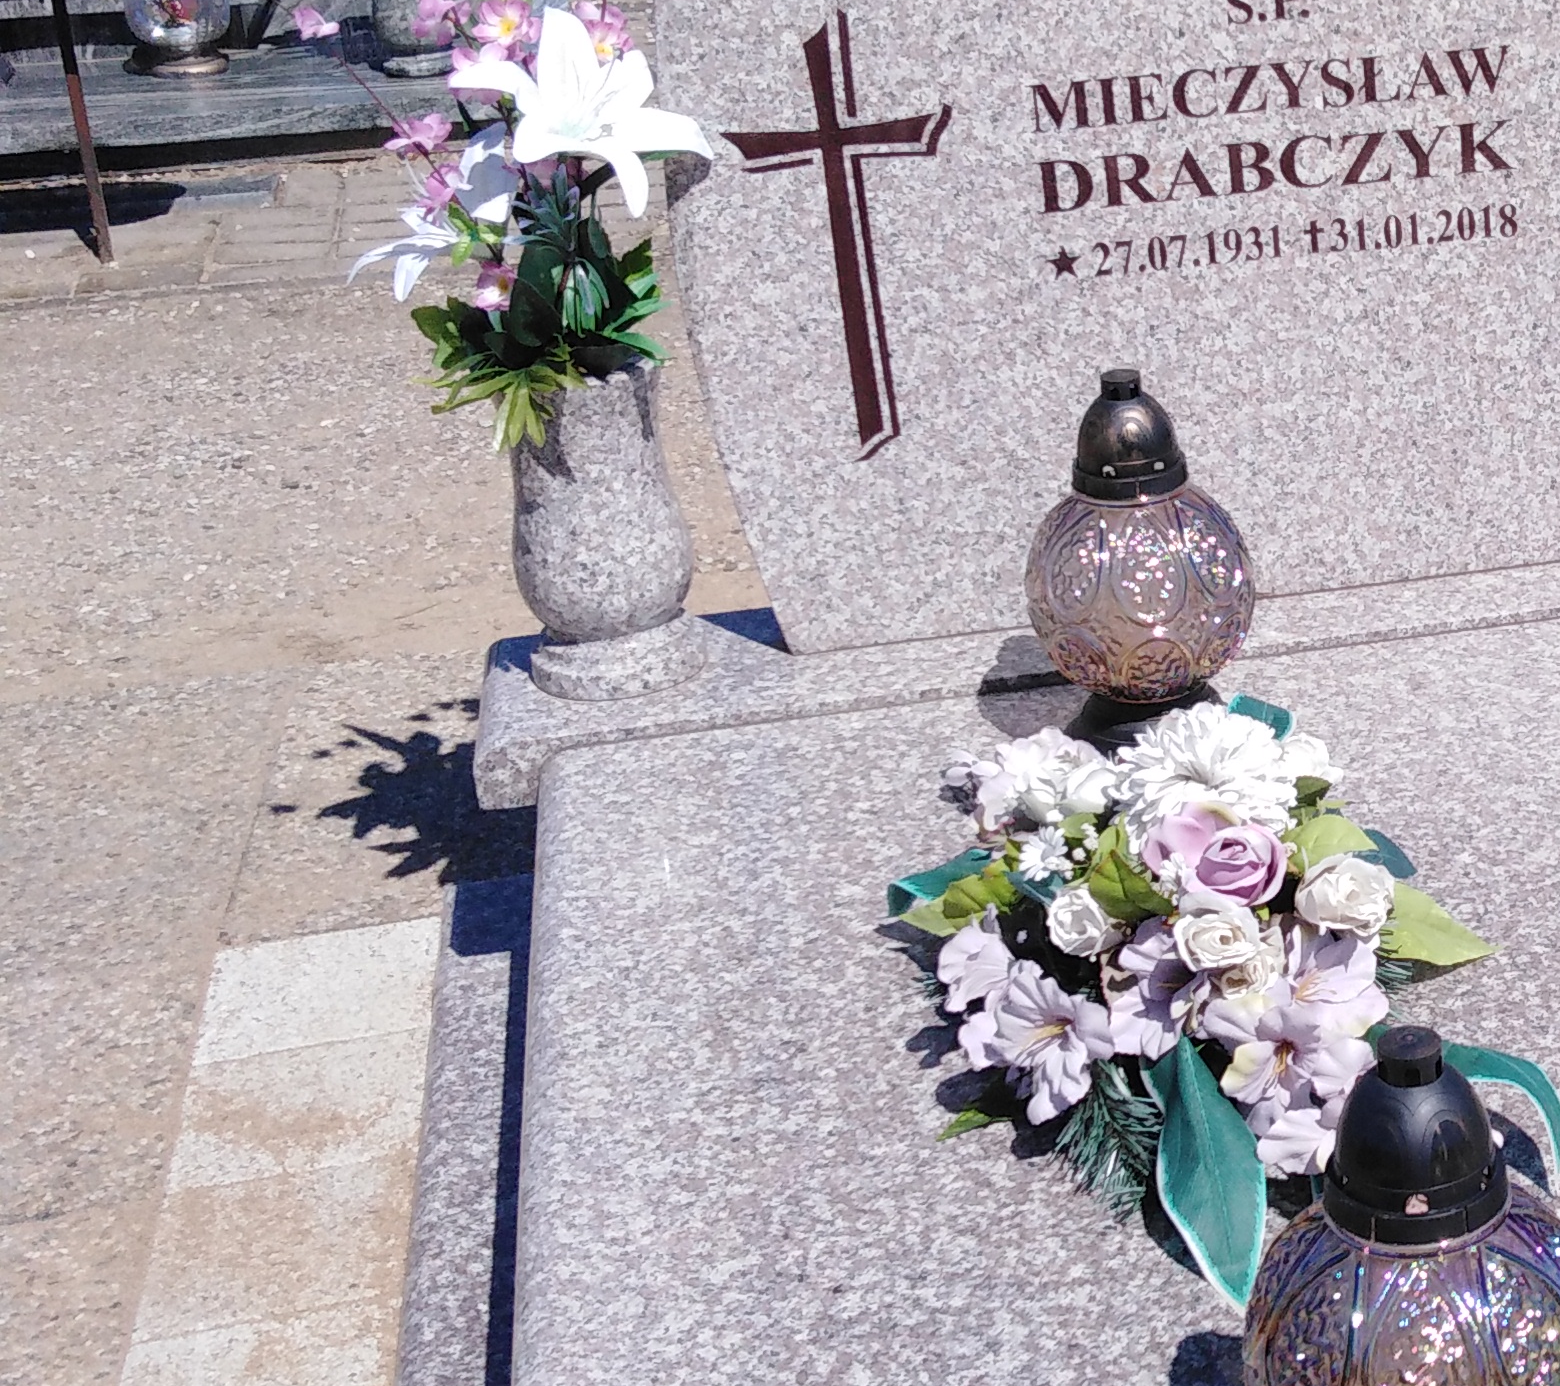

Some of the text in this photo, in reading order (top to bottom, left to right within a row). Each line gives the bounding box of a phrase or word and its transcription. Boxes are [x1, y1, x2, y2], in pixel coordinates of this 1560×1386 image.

[1029, 44, 1510, 133] MIECZYSŁAW
[1038, 119, 1517, 214] DRABCZYK
[1094, 223, 1283, 278] 27.07.1931
